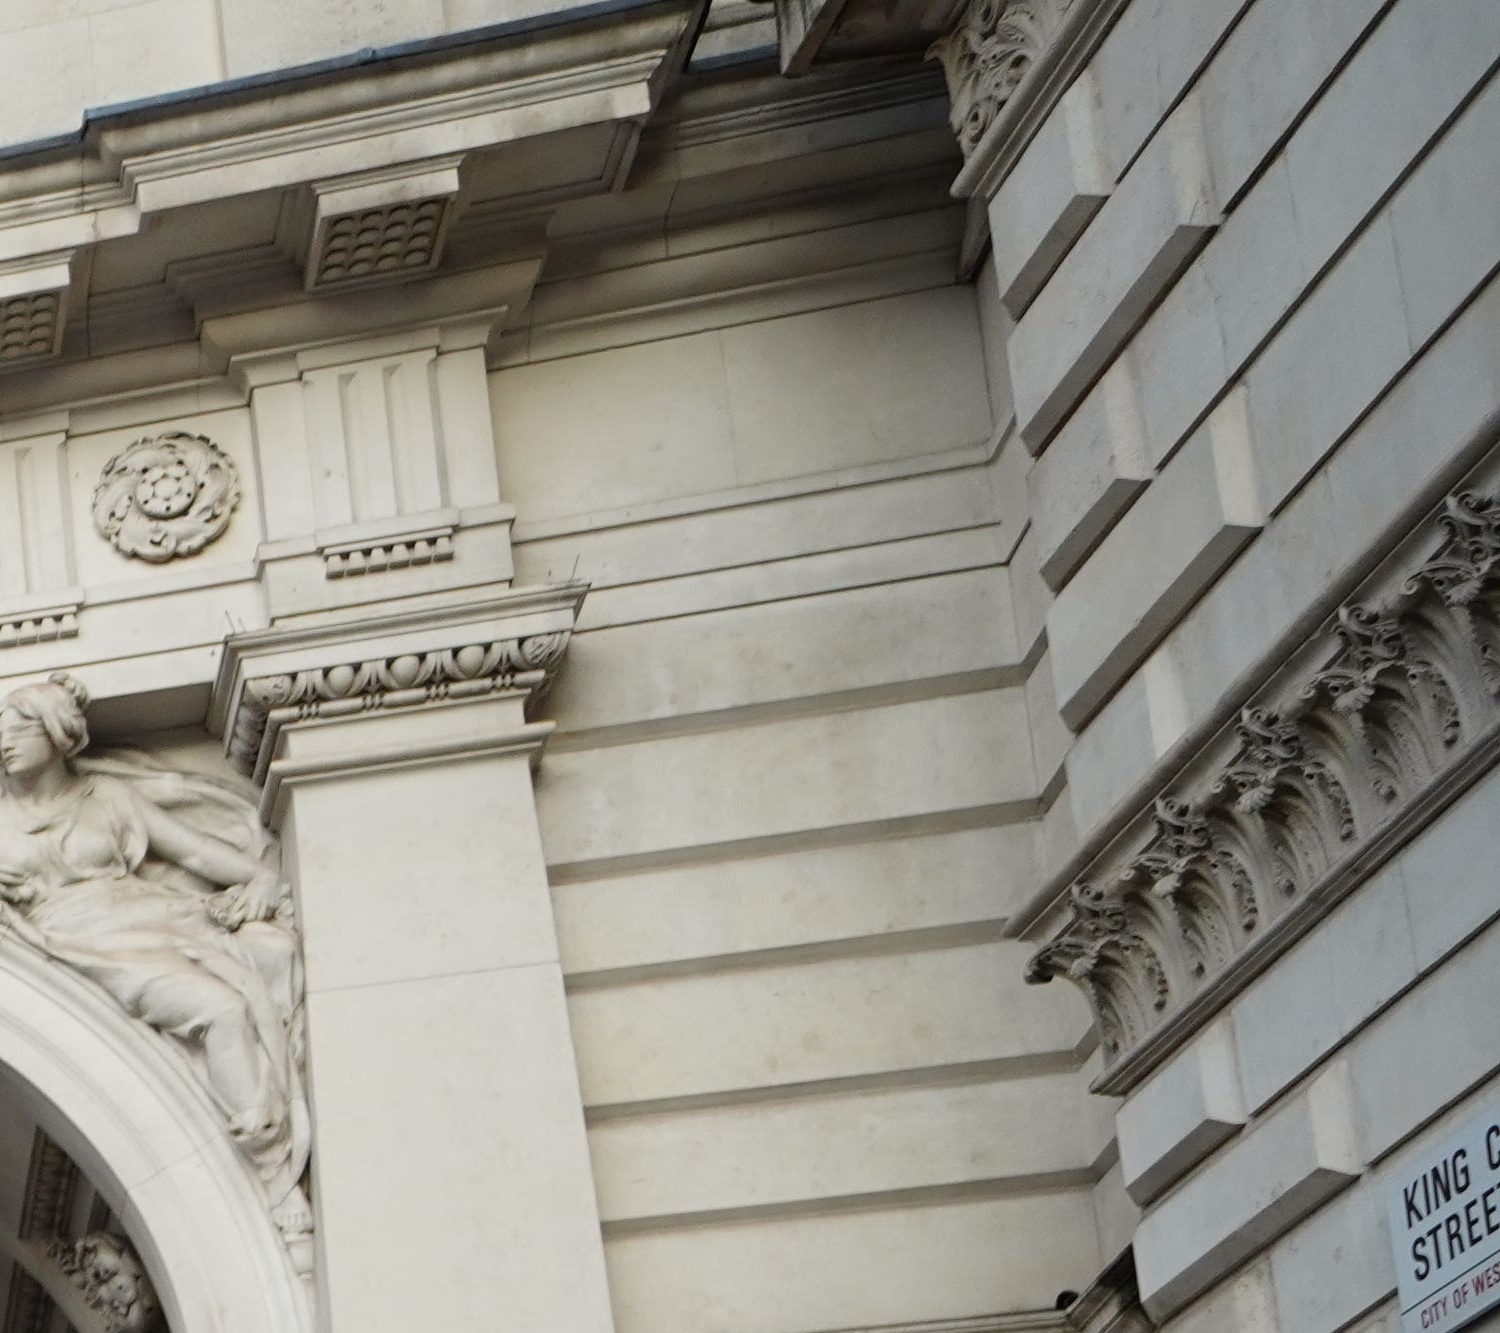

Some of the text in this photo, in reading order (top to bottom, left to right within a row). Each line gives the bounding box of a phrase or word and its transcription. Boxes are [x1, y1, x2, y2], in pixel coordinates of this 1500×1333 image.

[1403, 1148, 1470, 1230] KING
[1411, 1183, 1500, 1281] STREE
[1421, 1296, 1448, 1330] CITY
[1453, 1284, 1469, 1310] OF
